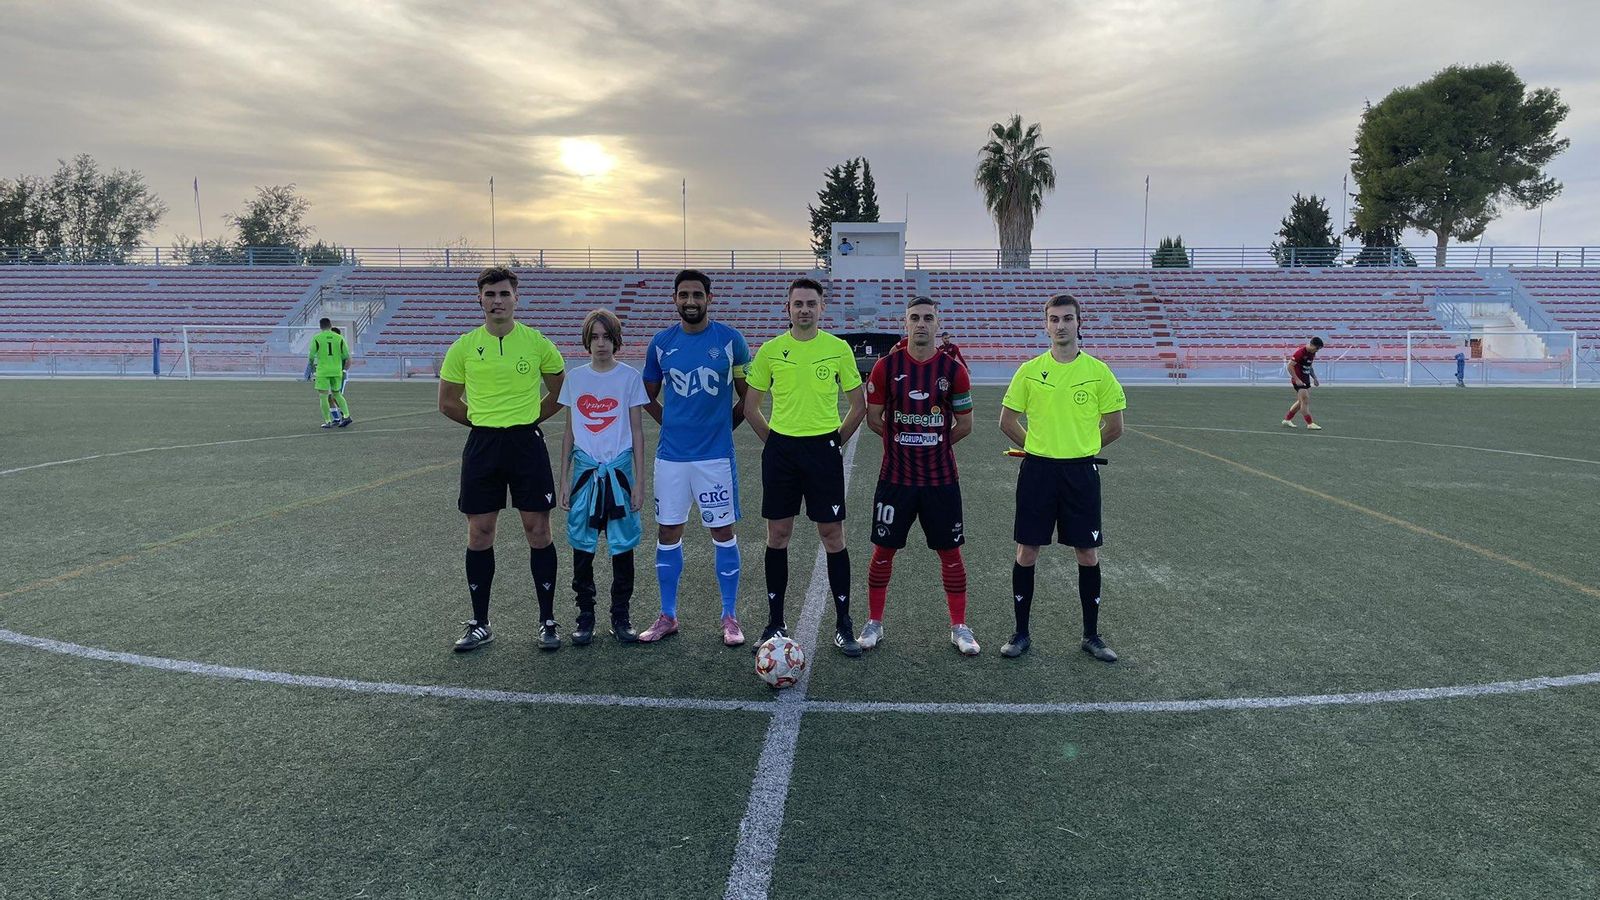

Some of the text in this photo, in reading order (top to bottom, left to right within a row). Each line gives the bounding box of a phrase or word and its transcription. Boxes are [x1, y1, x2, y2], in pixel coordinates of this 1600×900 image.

[669, 366, 720, 398] SAC
[894, 406, 944, 427] Peregrin
[699, 490, 730, 503] CRC
[876, 502, 895, 525] 10
